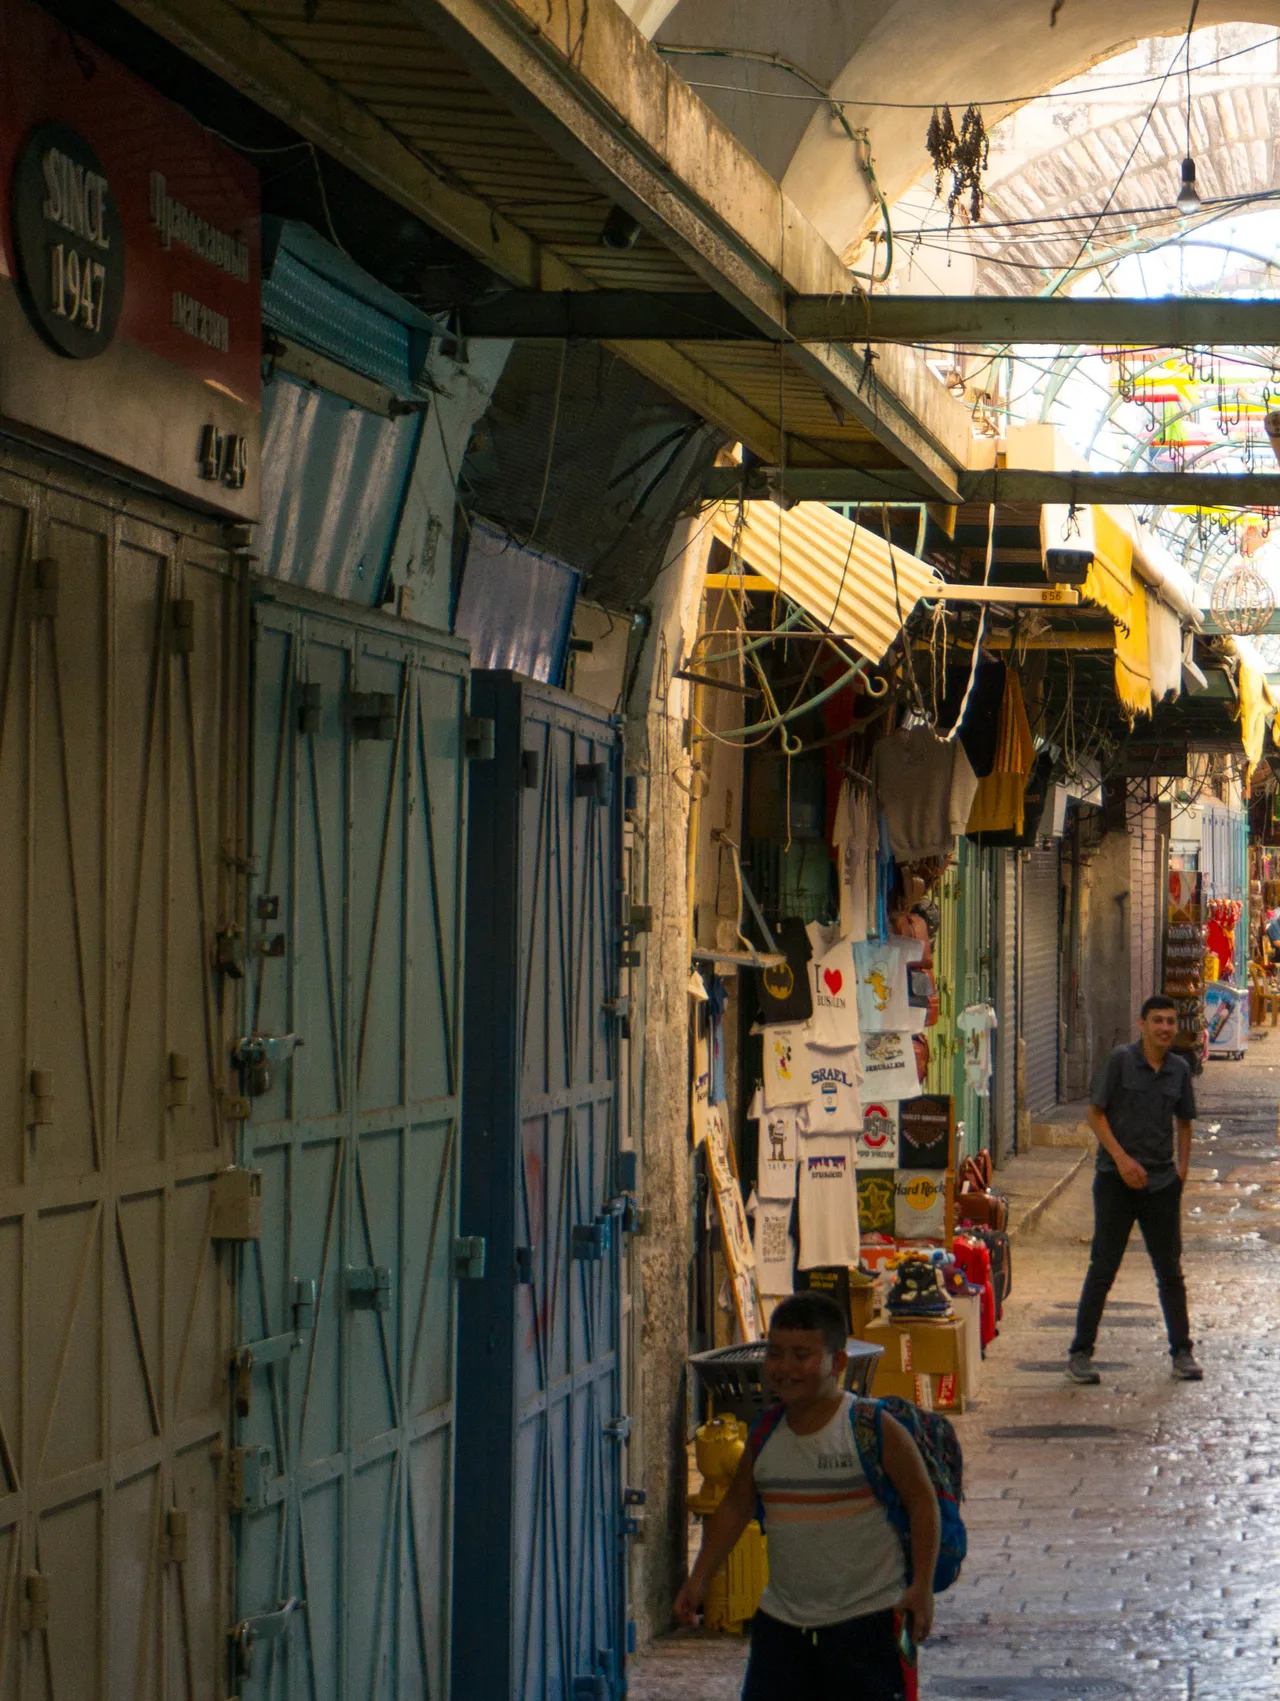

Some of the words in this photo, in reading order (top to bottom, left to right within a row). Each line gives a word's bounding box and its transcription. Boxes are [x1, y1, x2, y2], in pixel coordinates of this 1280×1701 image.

[43, 147, 109, 249] SINCE
[51, 243, 106, 332] 1947
[1042, 591, 1061, 601] 656
[865, 1061, 906, 1072] JERUSALEM
[811, 1067, 853, 1088] SRAEL
[895, 1182, 919, 1196] Hard
